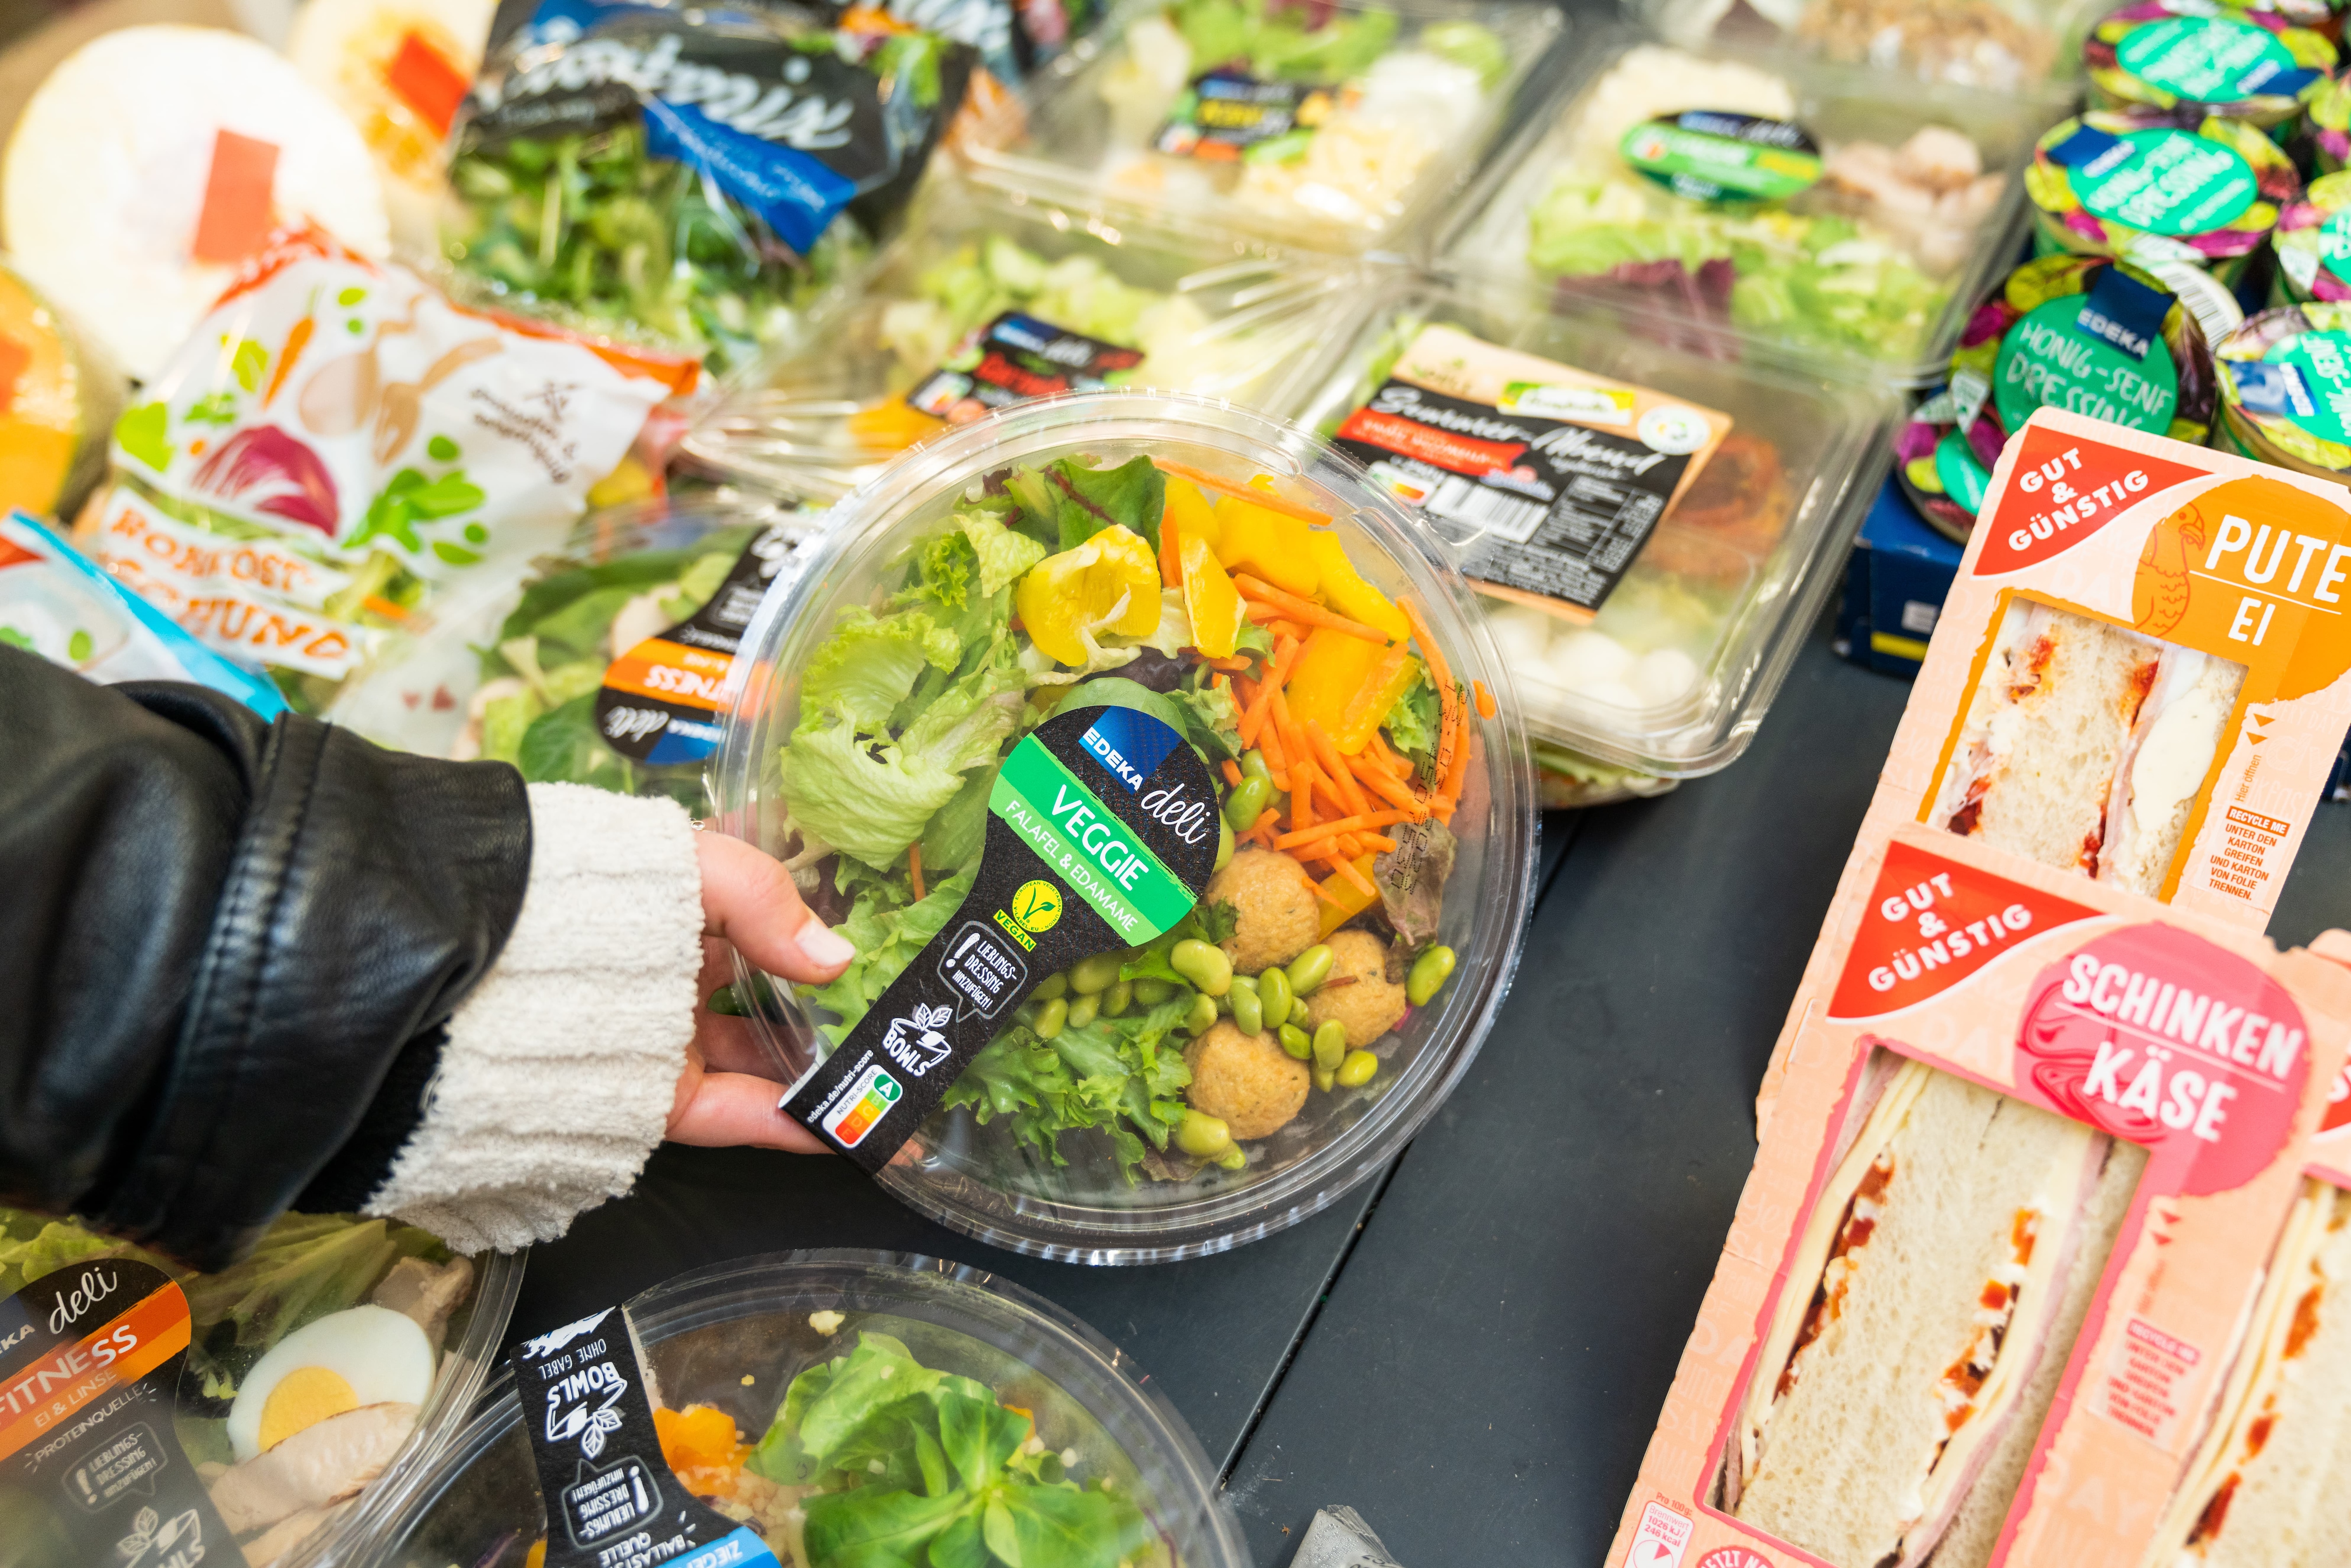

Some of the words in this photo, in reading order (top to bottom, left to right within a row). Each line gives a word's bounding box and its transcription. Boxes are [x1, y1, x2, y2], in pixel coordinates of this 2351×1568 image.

[2075, 307, 2150, 360] EDEKA
[2019, 447, 2084, 494] GUT
[2008, 469, 2150, 552] GÜNSTIG
[2052, 480, 2080, 506] &
[2204, 512, 2351, 604] PUTE
[2227, 596, 2276, 647] EI
[1082, 727, 1144, 791] EDEKA
[2241, 754, 2262, 783] öffnen
[2234, 785, 2249, 802] Hier
[1140, 782, 1212, 845] deli
[2229, 808, 2270, 829] RECYCLE
[2270, 820, 2288, 835] ME
[1051, 784, 1149, 892] VEGGIE
[2225, 823, 2256, 841] UNTER
[2256, 833, 2278, 847] DEN
[2227, 836, 2266, 856] KARTON
[1005, 800, 1059, 857] FALAFEL
[1059, 853, 1072, 870] &
[1069, 864, 1138, 932] EDAMAME
[2210, 855, 2230, 869] UND
[2231, 861, 2270, 882] KARTON
[2224, 848, 2264, 867] GREIFEN
[1015, 881, 1041, 900] EUROPEAN
[1042, 882, 1062, 913] VEGETARIAN
[1880, 872, 1953, 922] GUT
[2209, 878, 2252, 901] TRENNEN.
[2210, 867, 2230, 882] VON
[2231, 874, 2258, 890] FOLIE
[996, 911, 1035, 951] VEGAN
[1013, 906, 1039, 931] V-LABEL.EU
[1044, 914, 1060, 930] UNION
[1918, 911, 1947, 938] &
[977, 940, 1018, 980] LIEBLINGS-
[1868, 905, 2032, 991] GÜNSTIG
[952, 969, 994, 1010] HINZUFÜGEN!
[964, 954, 1004, 994] DRESSING
[2061, 953, 2303, 1080] SCHINKEN
[882, 1027, 930, 1077] BOWLS
[806, 1049, 874, 1124] edeka.de/nutri-score
[836, 1068, 878, 1116] NUTRI-SCORE
[878, 1081, 893, 1098] A
[2082, 1040, 2238, 1143] KÄSE
[49, 1266, 118, 1334] deli
[538, 1354, 573, 1380] GABEL
[576, 1338, 607, 1363] OHNE
[34, 1411, 51, 1428] EI
[52, 1402, 68, 1416] &
[68, 1367, 117, 1405] LINSE
[547, 1361, 621, 1410] BOWLS
[35, 1384, 143, 1462] PROTEINQUELLE
[571, 1467, 625, 1504] HINZUFÜGEN!
[579, 1483, 630, 1521] DRESSING
[1656, 1492, 1670, 1506] Pro
[578, 1501, 636, 1540] LIEBLINGS-
[1644, 1524, 1661, 1539] 246
[1661, 1531, 1681, 1548] kcal
[1647, 1515, 1669, 1532] 1026
[1648, 1504, 1689, 1531] Brennwert
[599, 1532, 652, 1568] QUELLE
